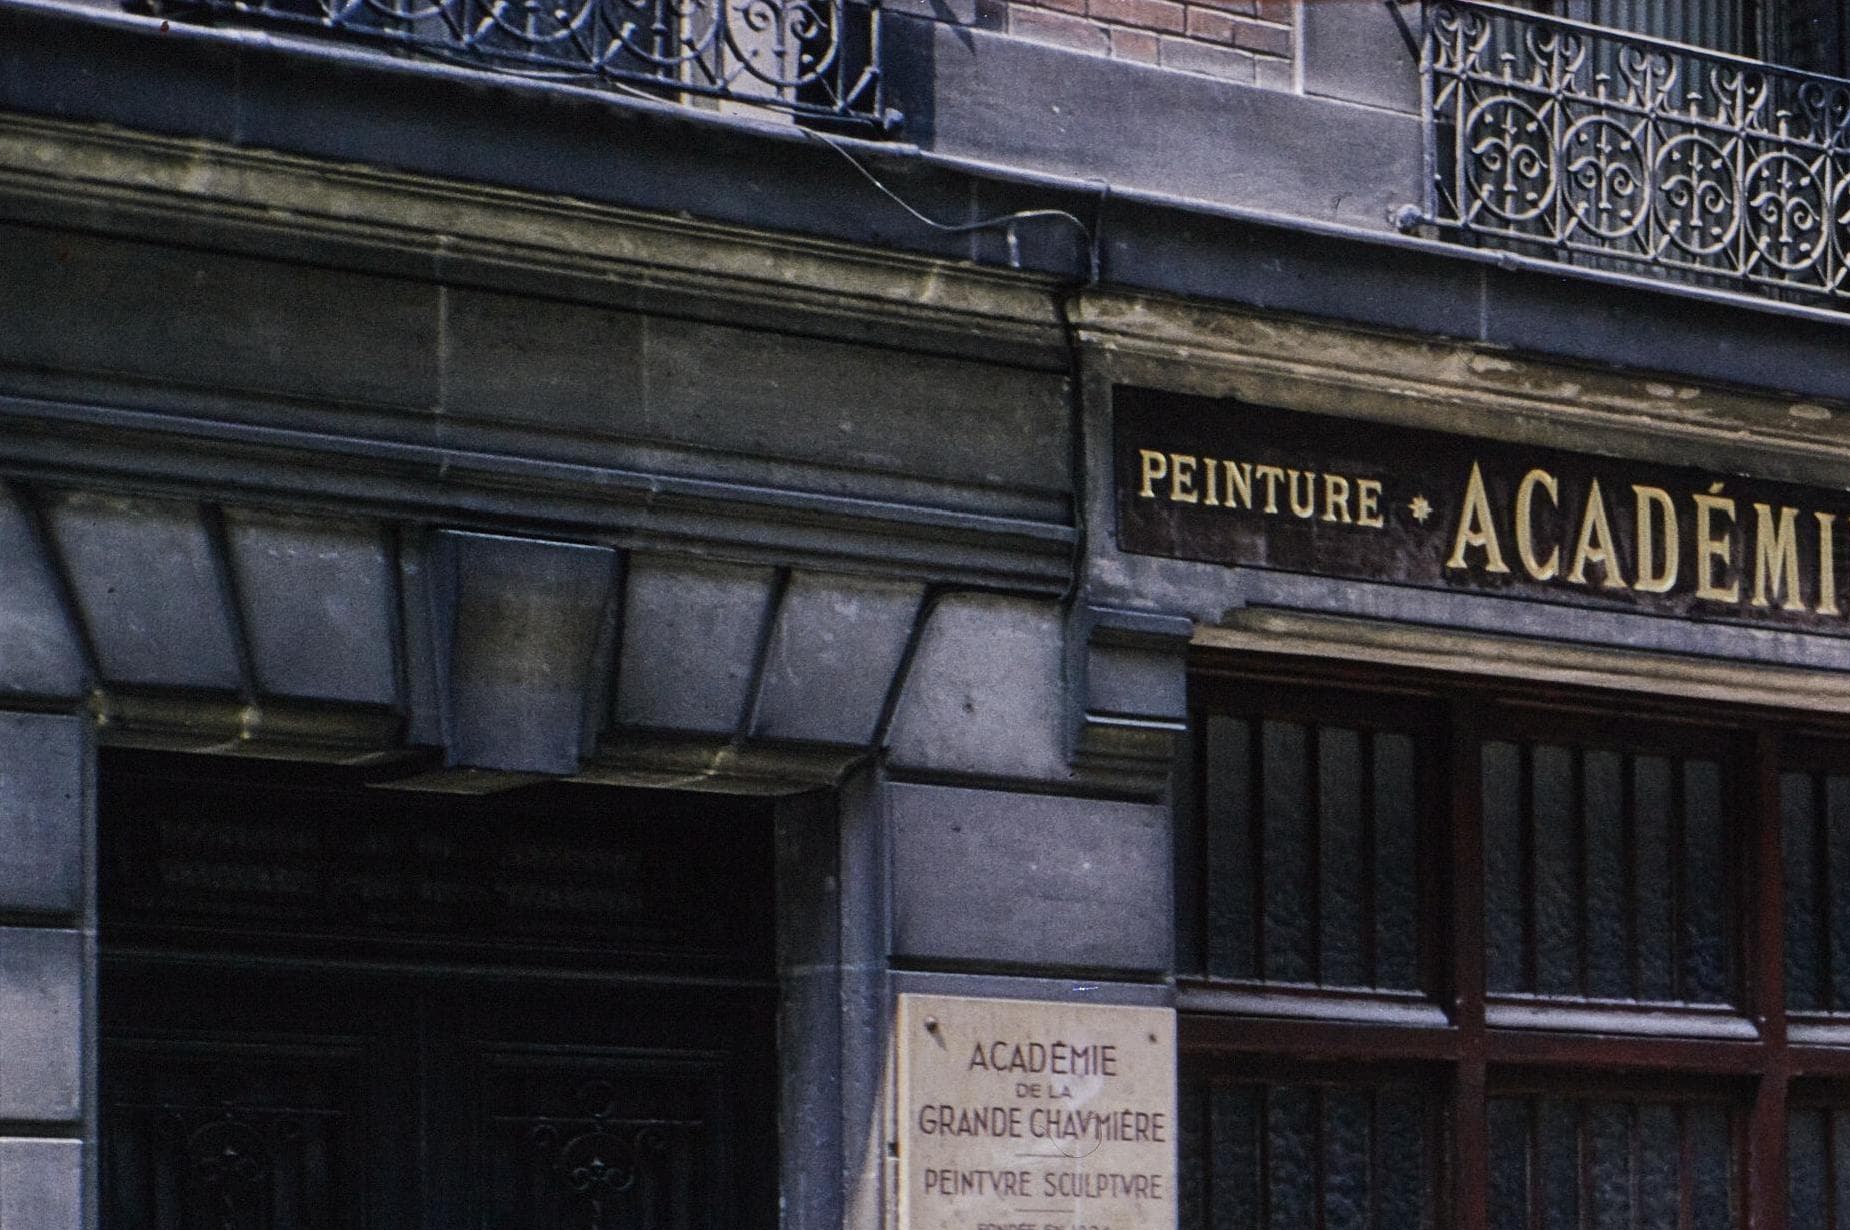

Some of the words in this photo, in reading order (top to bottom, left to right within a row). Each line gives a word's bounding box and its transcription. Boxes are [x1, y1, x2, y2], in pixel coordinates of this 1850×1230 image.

[1138, 449, 1384, 528] PEINTURE
[968, 1040, 1118, 1076] ACADÉMIE
[1015, 1083, 1041, 1099] DE
[1048, 1084, 1073, 1099] LA
[918, 1104, 1023, 1138] GRANDE
